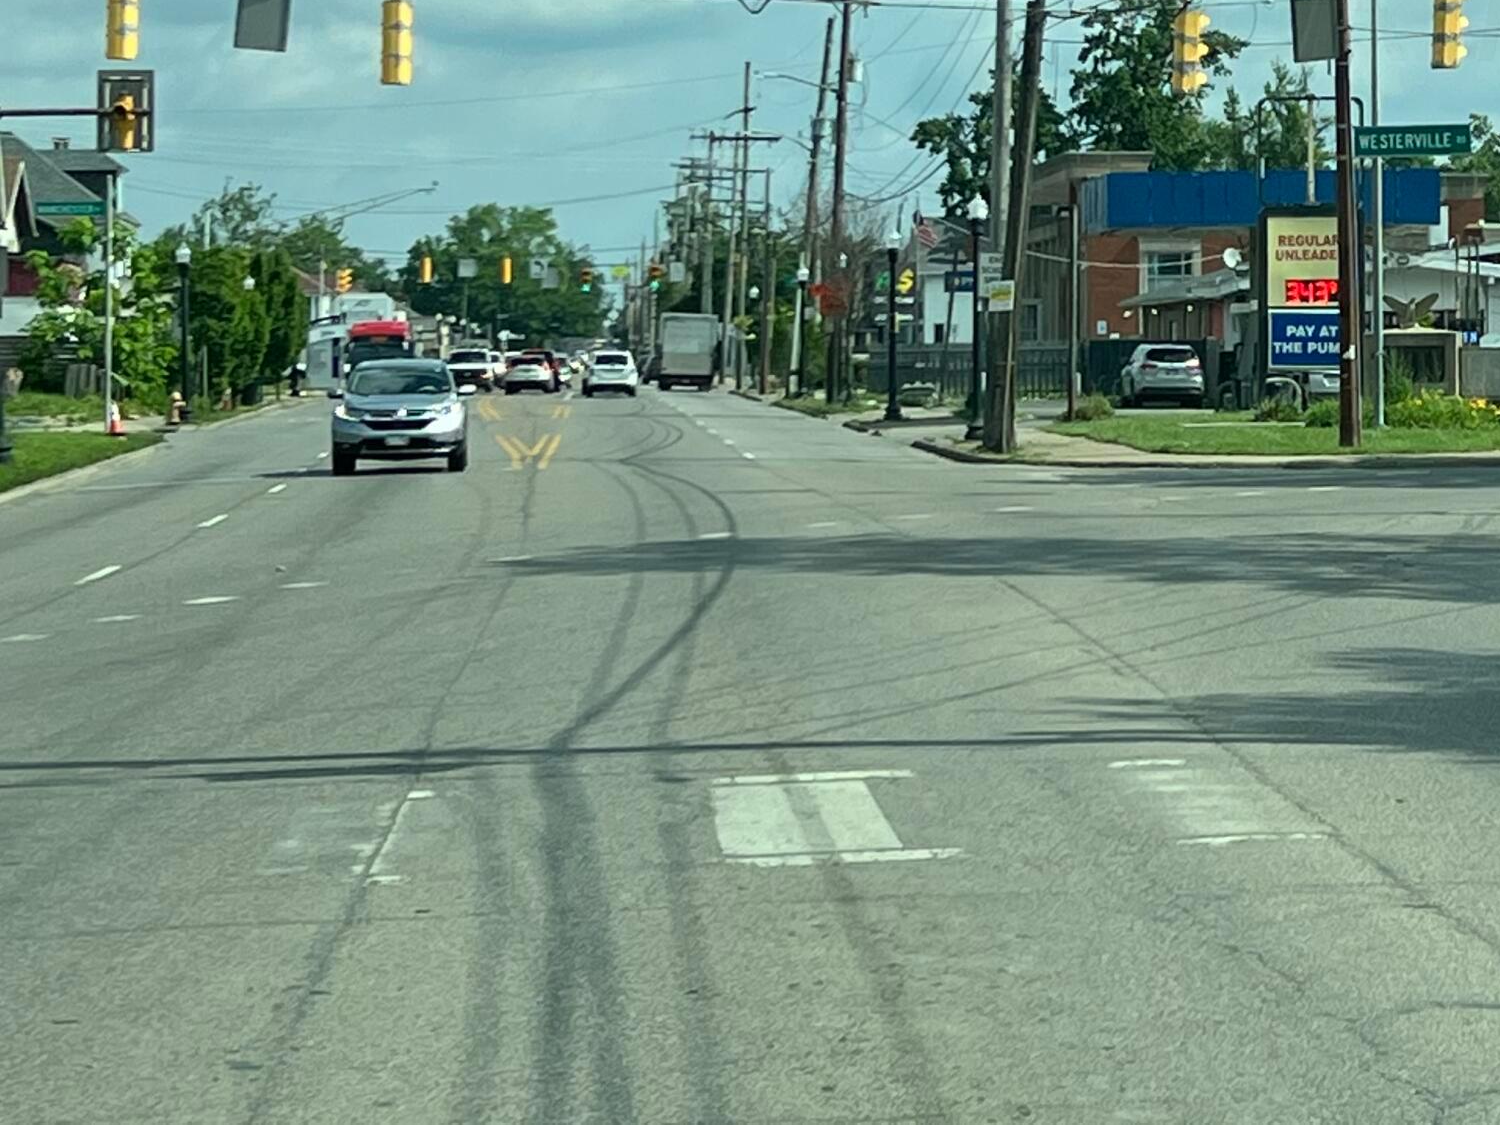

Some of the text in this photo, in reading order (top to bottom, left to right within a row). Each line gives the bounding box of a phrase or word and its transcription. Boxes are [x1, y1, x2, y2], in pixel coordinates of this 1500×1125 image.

[1359, 132, 1452, 149] WESTERVILLE
[1275, 249, 1337, 261] UNLEADE
[1285, 325, 1338, 337] PAY AT
[1273, 341, 1340, 354] THE PUM
